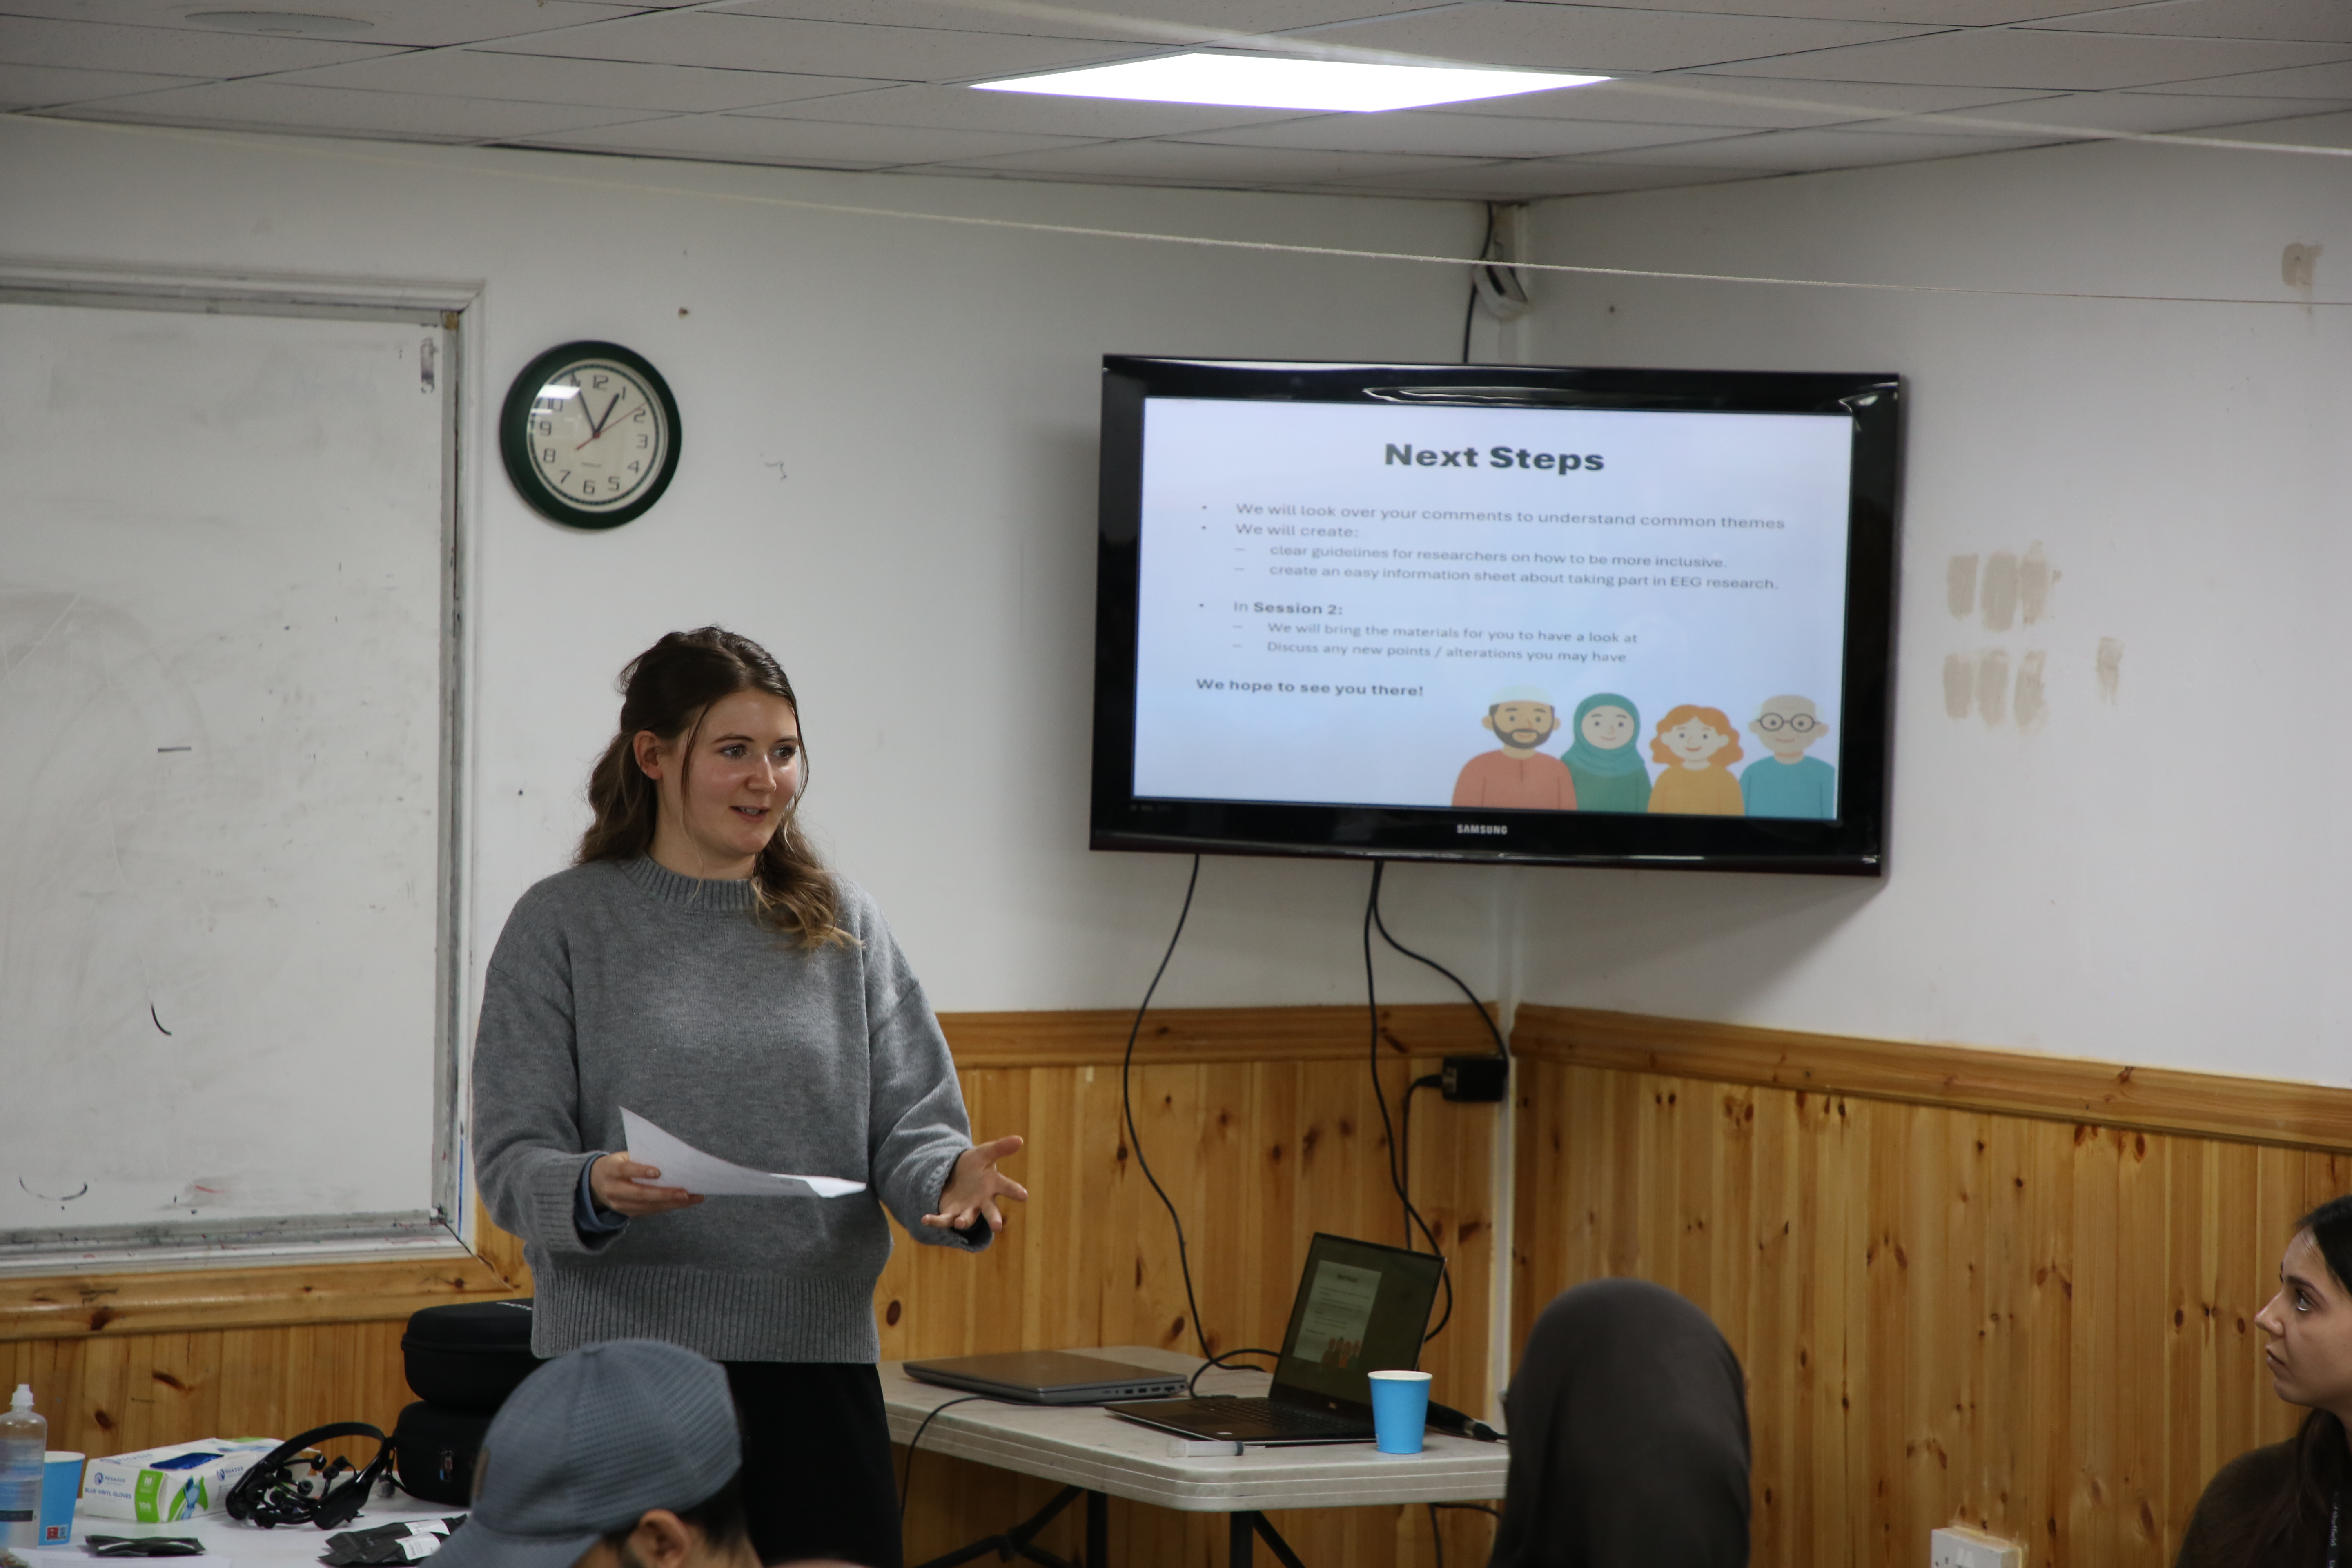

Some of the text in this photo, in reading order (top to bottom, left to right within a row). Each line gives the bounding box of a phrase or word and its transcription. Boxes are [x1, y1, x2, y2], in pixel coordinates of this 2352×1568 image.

[593, 374, 608, 390] 12
[621, 386, 626, 400] 1
[633, 410, 646, 423] 2
[540, 421, 552, 436] 9
[637, 433, 648, 449] 3
[543, 448, 556, 463] 8
[1385, 444, 1604, 476] Next Steps
[628, 460, 639, 474] 4
[560, 469, 571, 484] 7
[608, 476, 619, 491] 5
[583, 480, 595, 495] 6
[1236, 503, 1785, 529] We will look over your comments to understand common themes
[1236, 523, 1358, 537] We will create:
[1270, 545, 1727, 568] clear guidelines for researchers on how to be more inclusive.
[1269, 566, 1778, 590] create an easy information sheet about taking part in EEG research.
[1234, 601, 1342, 615] In Session 2:
[1268, 623, 1637, 644] We will bring the materials for you to have a look at
[1267, 641, 1319, 653] Discuss
[1323, 645, 1348, 656] any
[1352, 646, 1383, 655] new
[1387, 647, 1431, 657] points
[1446, 647, 1523, 659] alterations
[1527, 652, 1553, 662] you
[1557, 653, 1588, 663] may
[1592, 650, 1627, 663] have
[1196, 679, 1423, 696] We hope to see you there!
[1457, 824, 1508, 834] SAMSUNG
[144, 1477, 152, 1485] M
